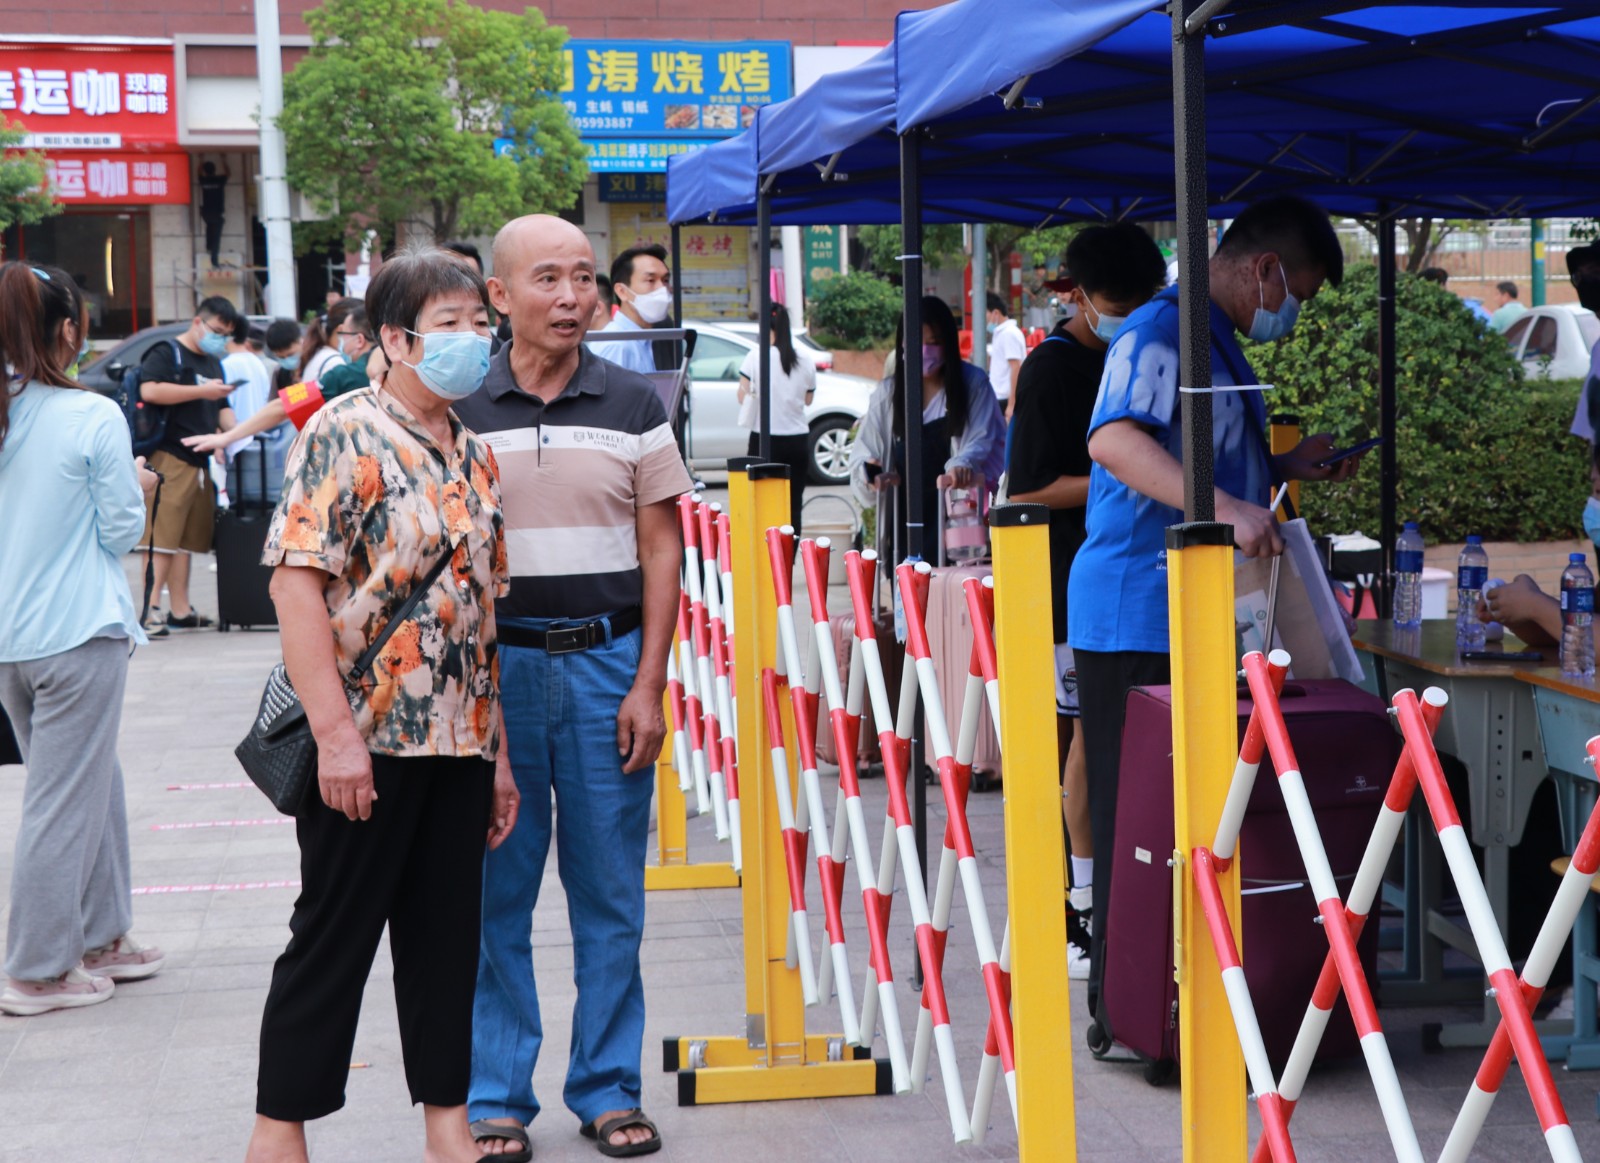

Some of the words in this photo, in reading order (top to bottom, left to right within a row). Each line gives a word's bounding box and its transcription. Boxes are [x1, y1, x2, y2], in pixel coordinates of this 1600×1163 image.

[125, 73, 167, 93] 现磨
[126, 94, 168, 114] 咖啡
[586, 100, 613, 113] 生蚝
[24, 159, 129, 197] 运咖
